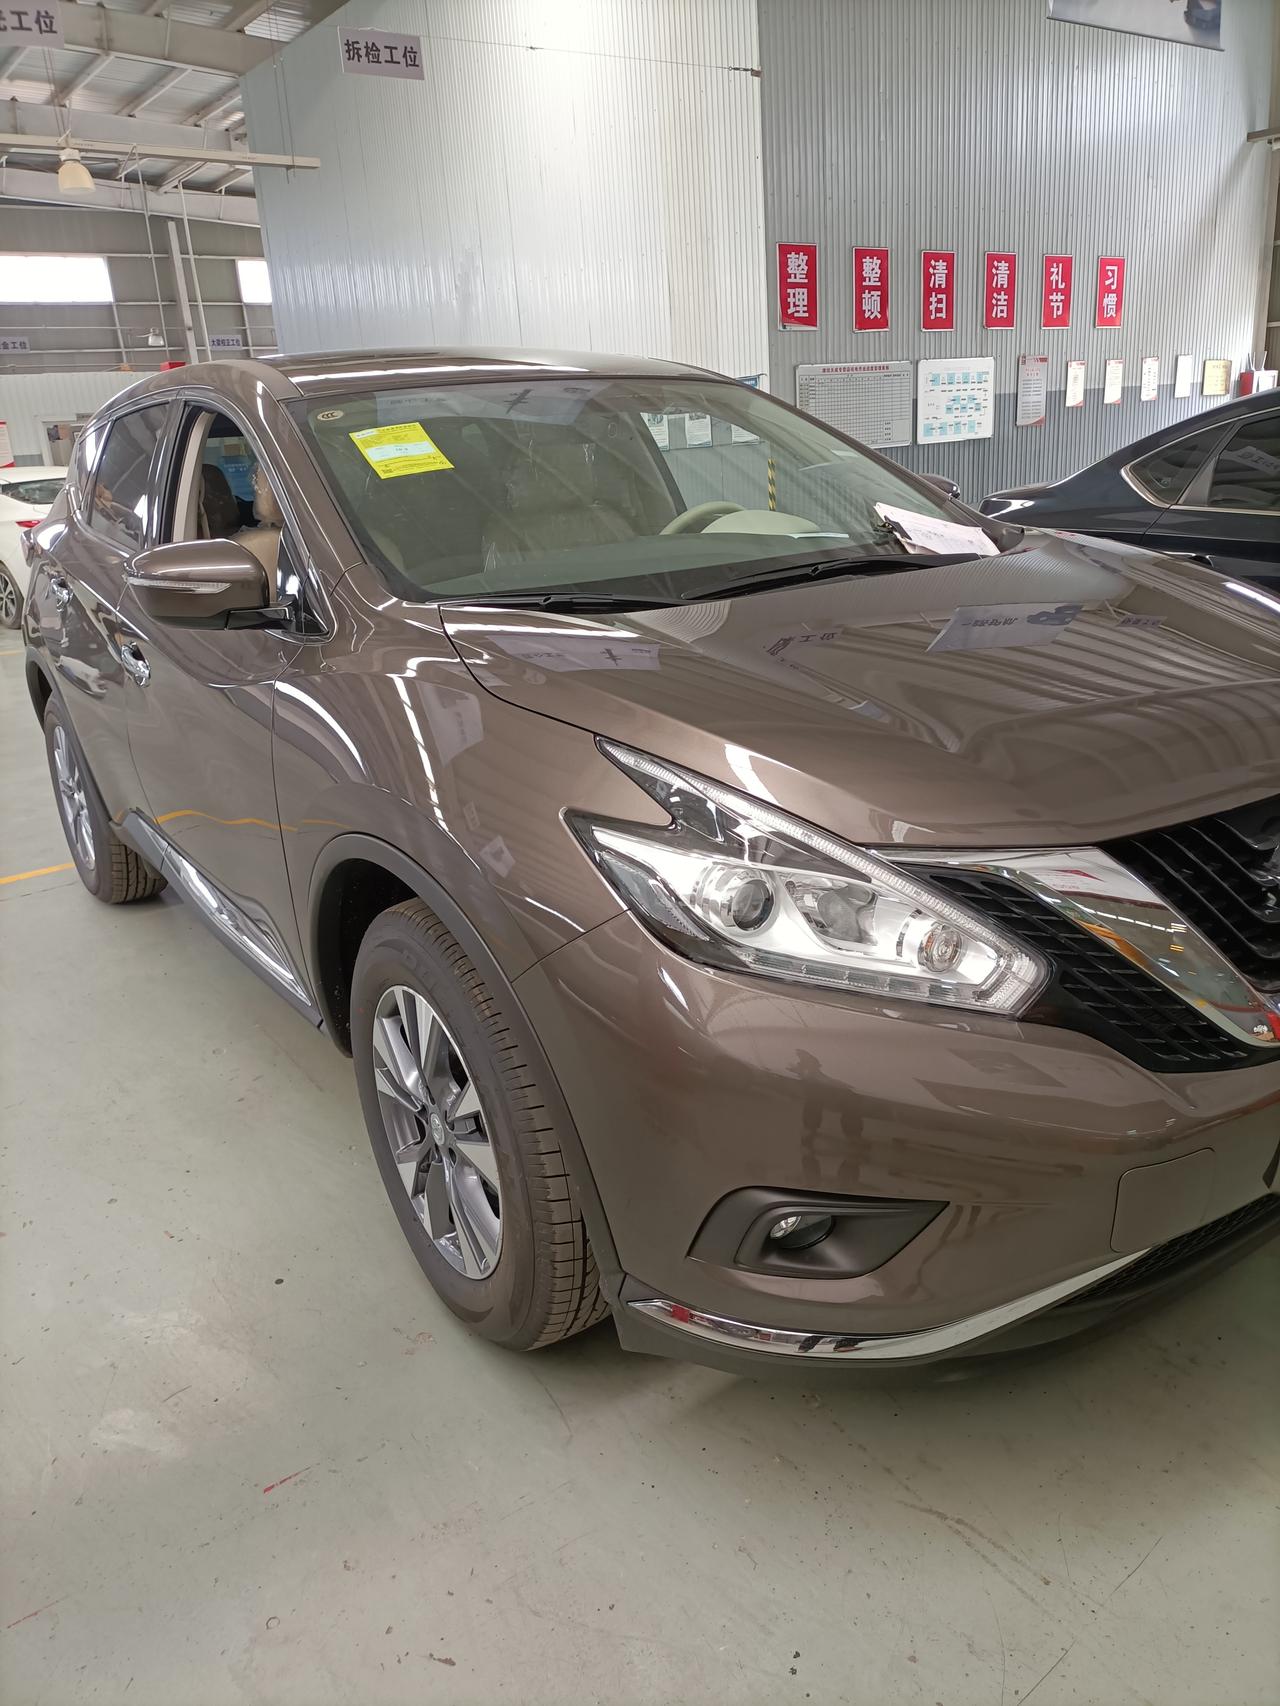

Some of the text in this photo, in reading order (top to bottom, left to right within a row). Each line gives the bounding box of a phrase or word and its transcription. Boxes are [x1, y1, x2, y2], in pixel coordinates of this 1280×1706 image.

[344, 39, 419, 68] 拆检工位
[787, 251, 809, 318] 整理
[862, 256, 882, 320] 整顿
[928, 259, 948, 320] 清扫
[991, 260, 1010, 319] 清洁
[1049, 262, 1066, 319] 礼节
[1102, 265, 1118, 318] 习惯
[0, 341, 27, 350] 金工位
